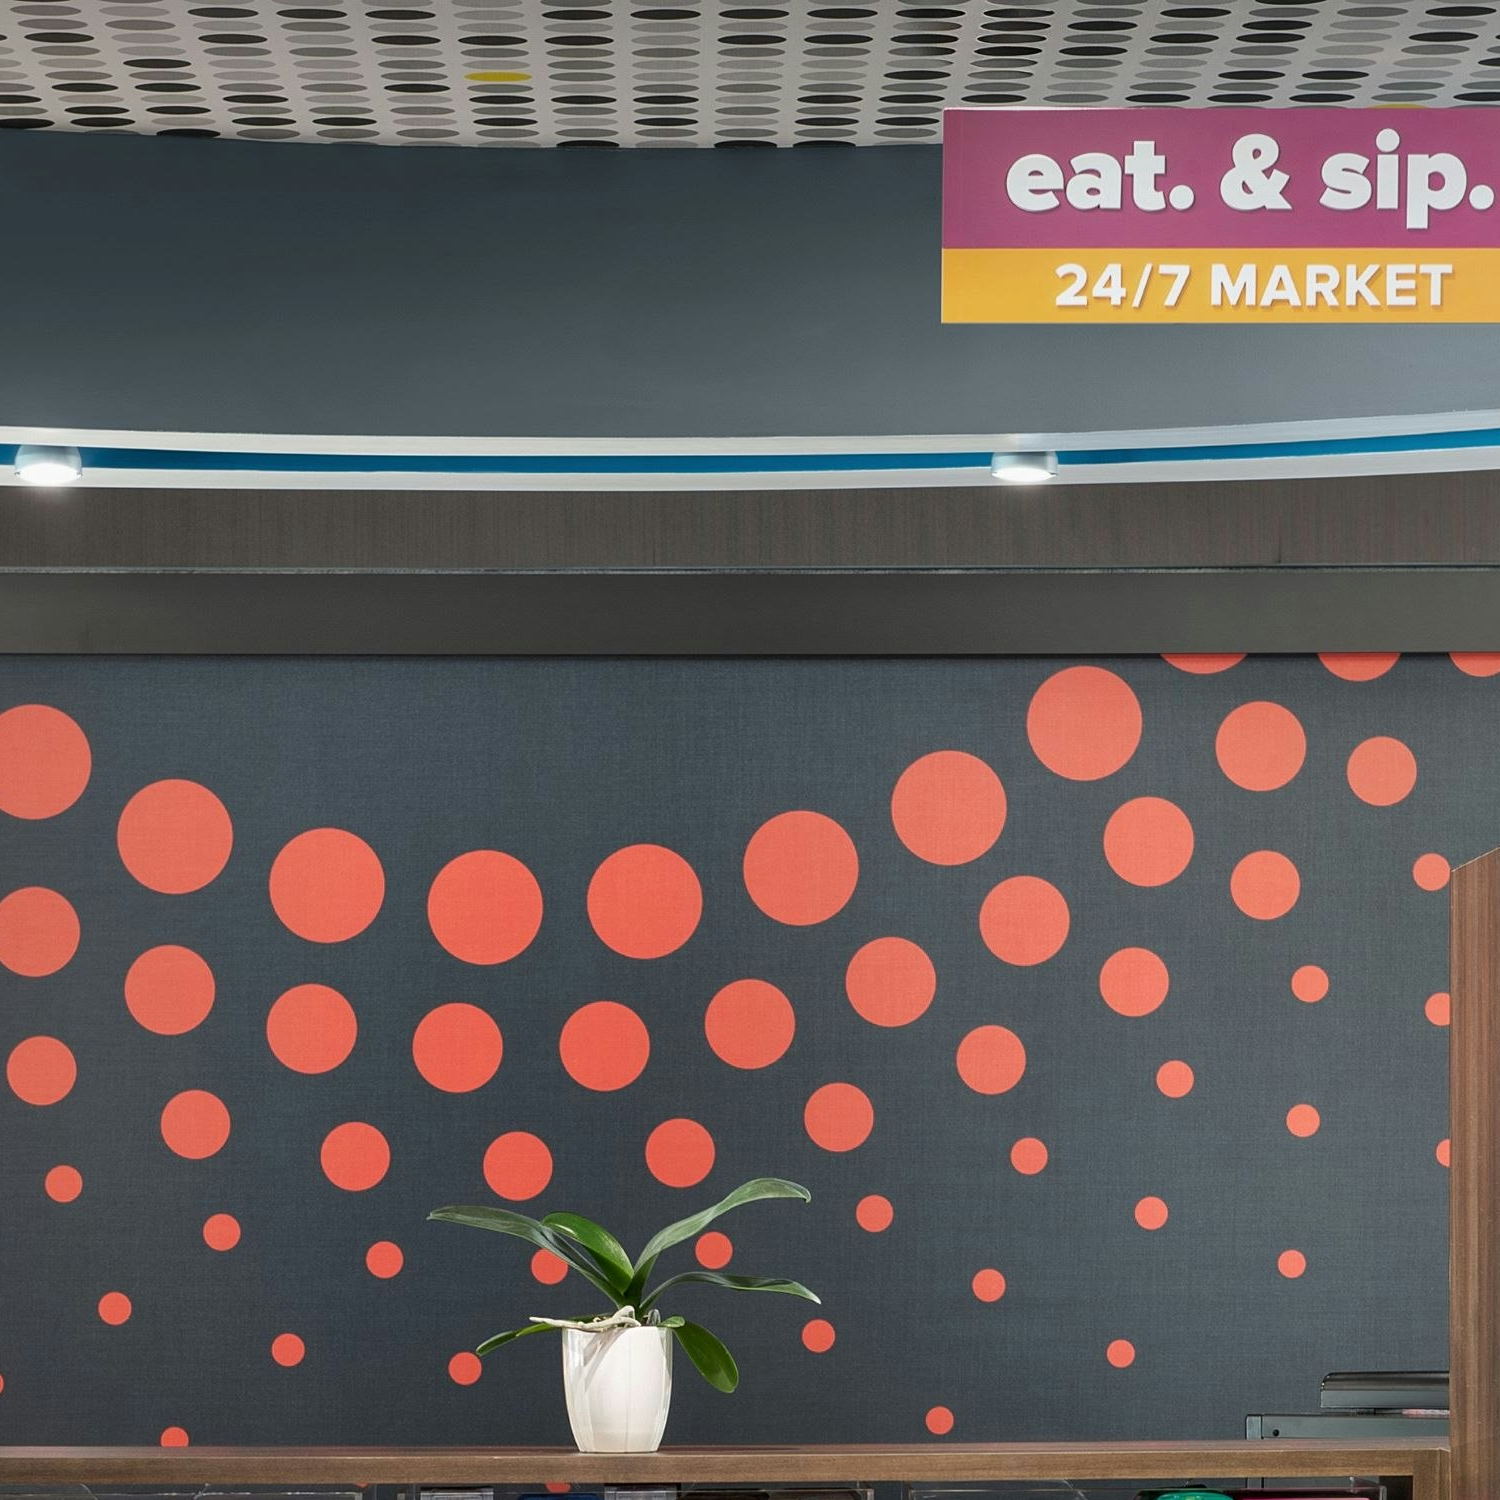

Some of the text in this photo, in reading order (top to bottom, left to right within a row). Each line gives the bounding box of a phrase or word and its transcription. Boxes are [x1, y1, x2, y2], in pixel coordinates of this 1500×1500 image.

[1005, 127, 1494, 229] eat. & sip.
[1054, 263, 1453, 309] 24/7 MARKET
